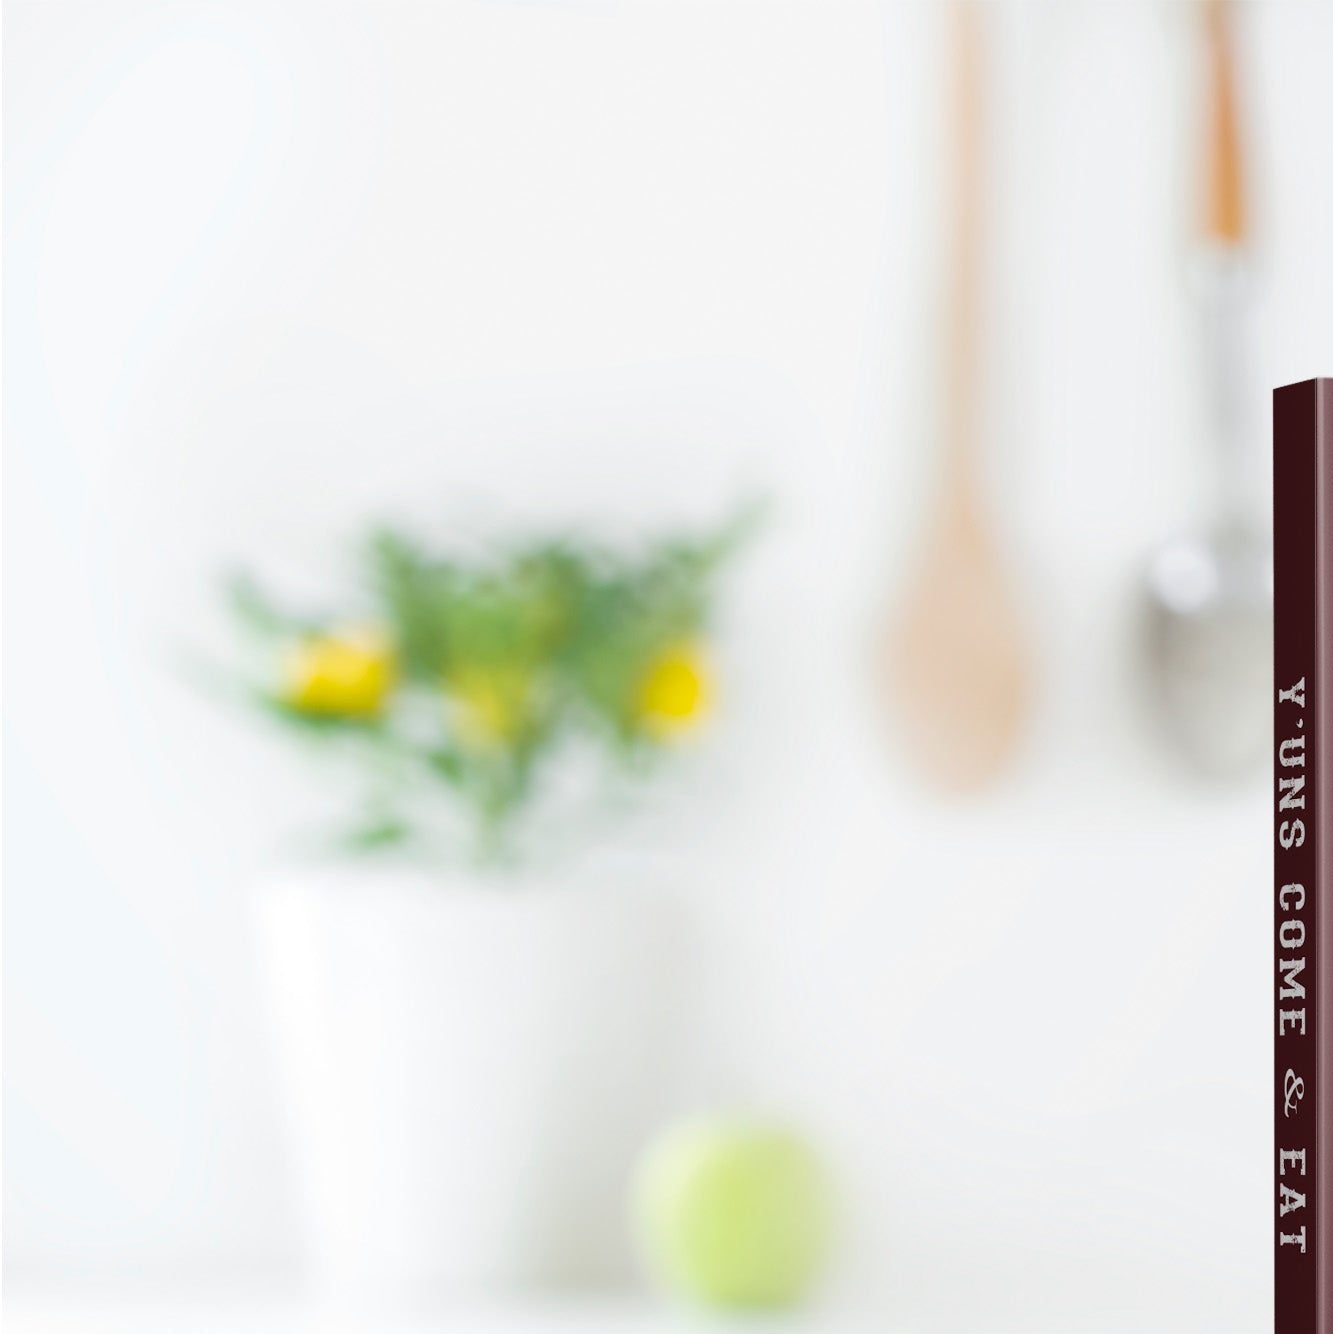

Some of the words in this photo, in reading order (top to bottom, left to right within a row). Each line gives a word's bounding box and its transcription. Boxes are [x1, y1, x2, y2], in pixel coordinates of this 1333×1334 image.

[1278, 676, 1306, 850] Y'UNS
[1279, 883, 1306, 1036] COME
[1284, 1069, 1305, 1118] &
[1279, 1148, 1307, 1254] EAT
